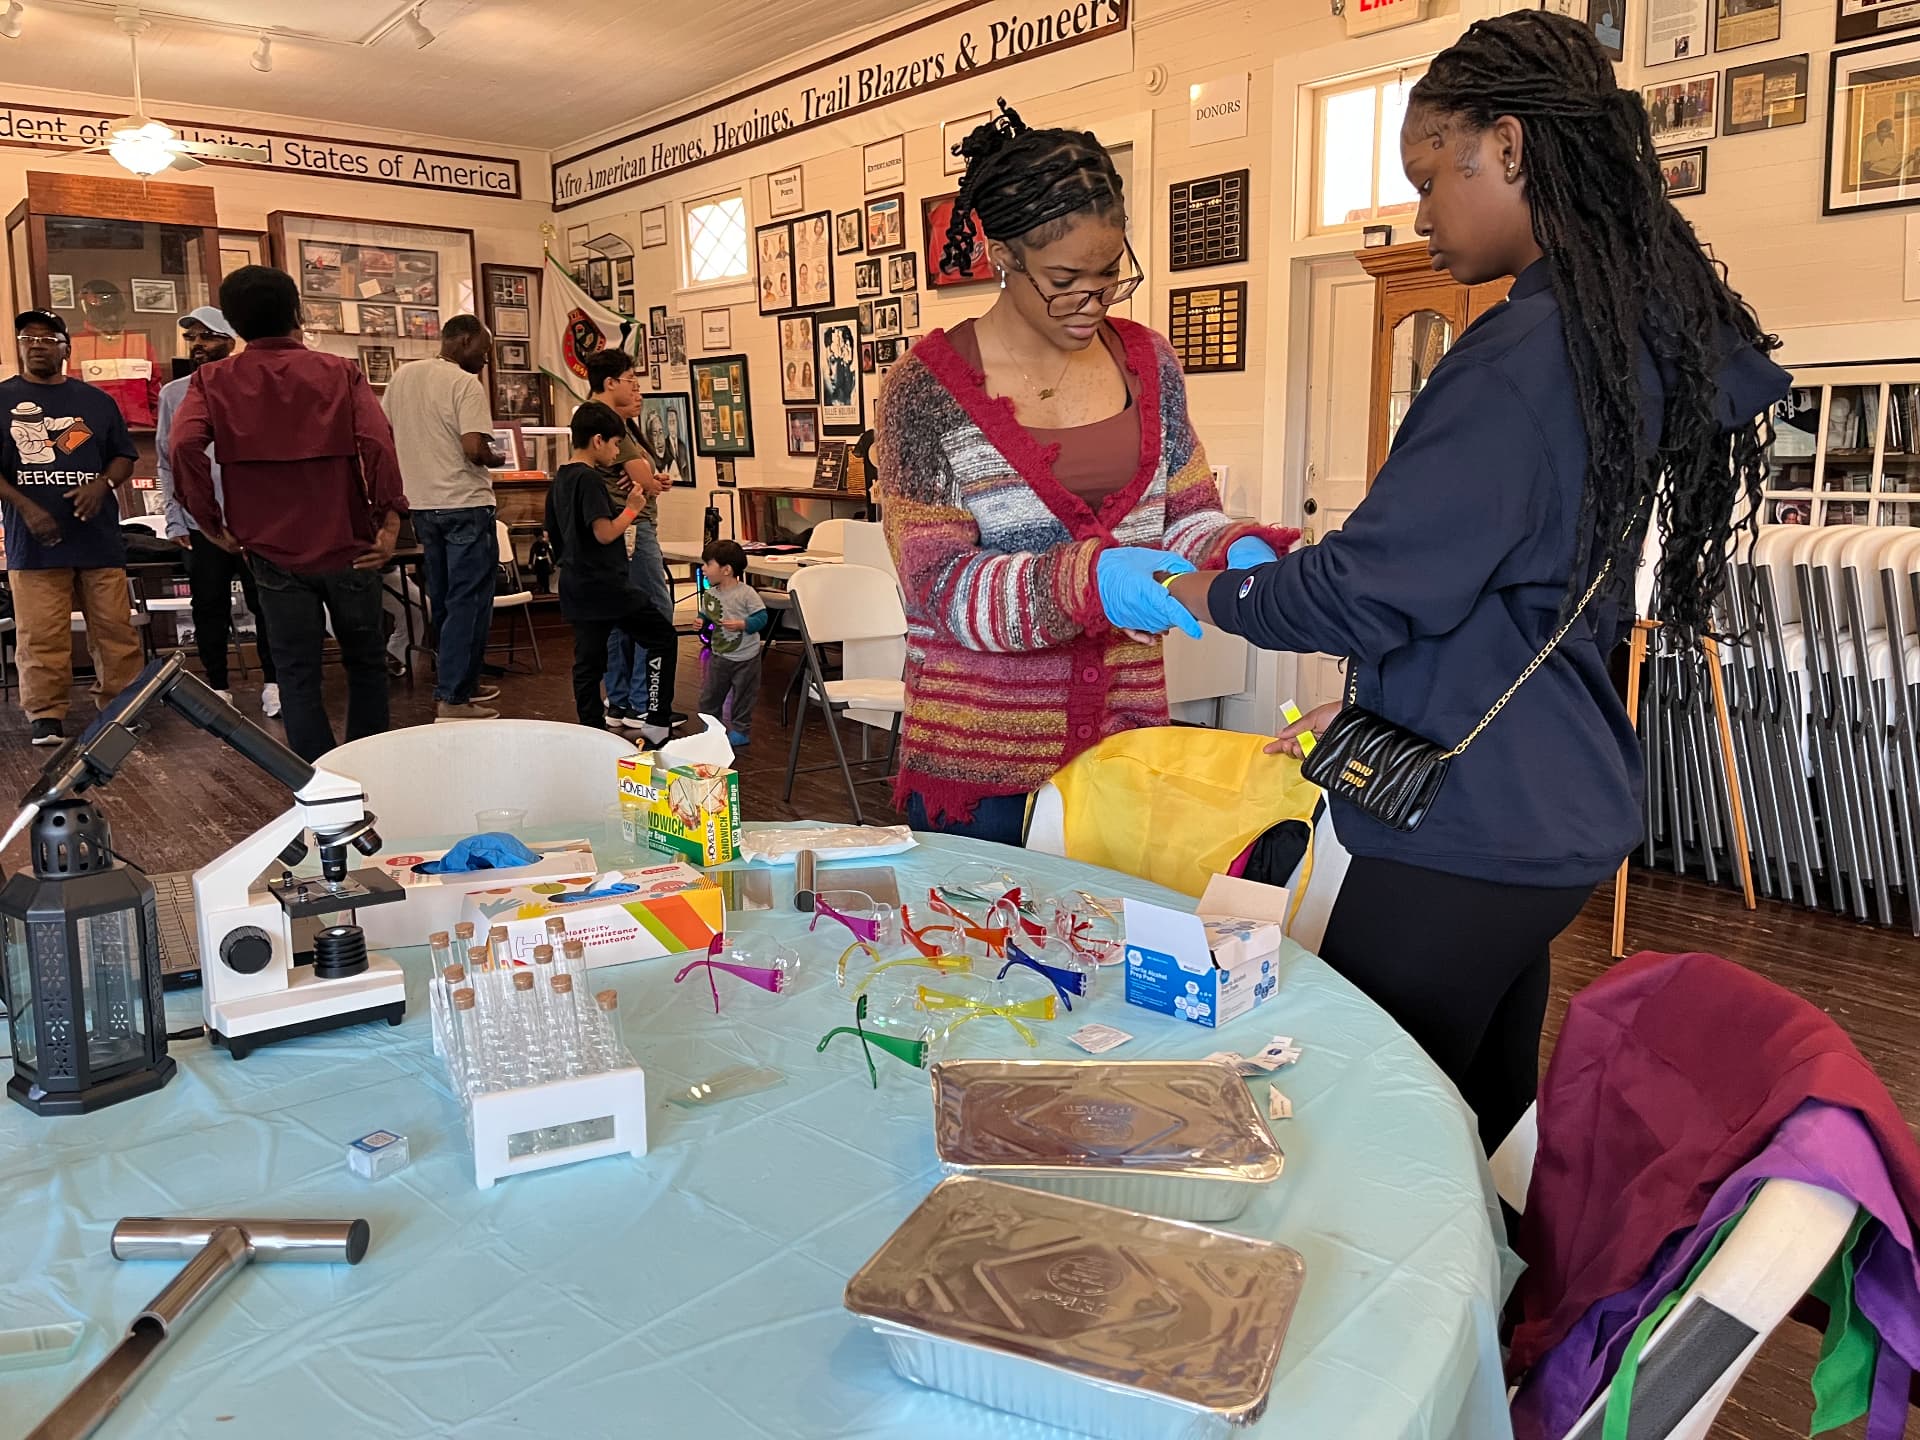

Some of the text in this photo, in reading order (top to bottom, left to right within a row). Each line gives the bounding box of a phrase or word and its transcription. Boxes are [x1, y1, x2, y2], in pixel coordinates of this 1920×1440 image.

[557, 175, 582, 199] Afro
[584, 155, 647, 192] American
[801, 75, 850, 121] Trail
[857, 52, 945, 103] Blazers
[954, 32, 980, 72] &
[988, 0, 1120, 62] Pioneers
[1195, 100, 1241, 121] DONORS
[80, 120, 110, 146] of
[284, 143, 369, 173] States
[378, 155, 404, 178] of
[412, 158, 511, 190] America
[17, 470, 100, 487] BEEKEEPE
[132, 478, 154, 489] LIFE
[648, 671, 660, 712] Reebok
[619, 779, 657, 801] HOMELINE
[730, 784, 739, 802] Bags
[636, 809, 684, 837] NDWICH
[731, 803, 740, 826] Zipper
[707, 821, 717, 860] HOMELINE
[719, 816, 731, 861] SANDWICH
[588, 935, 636, 947] resistance
[591, 927, 639, 939] resistance
